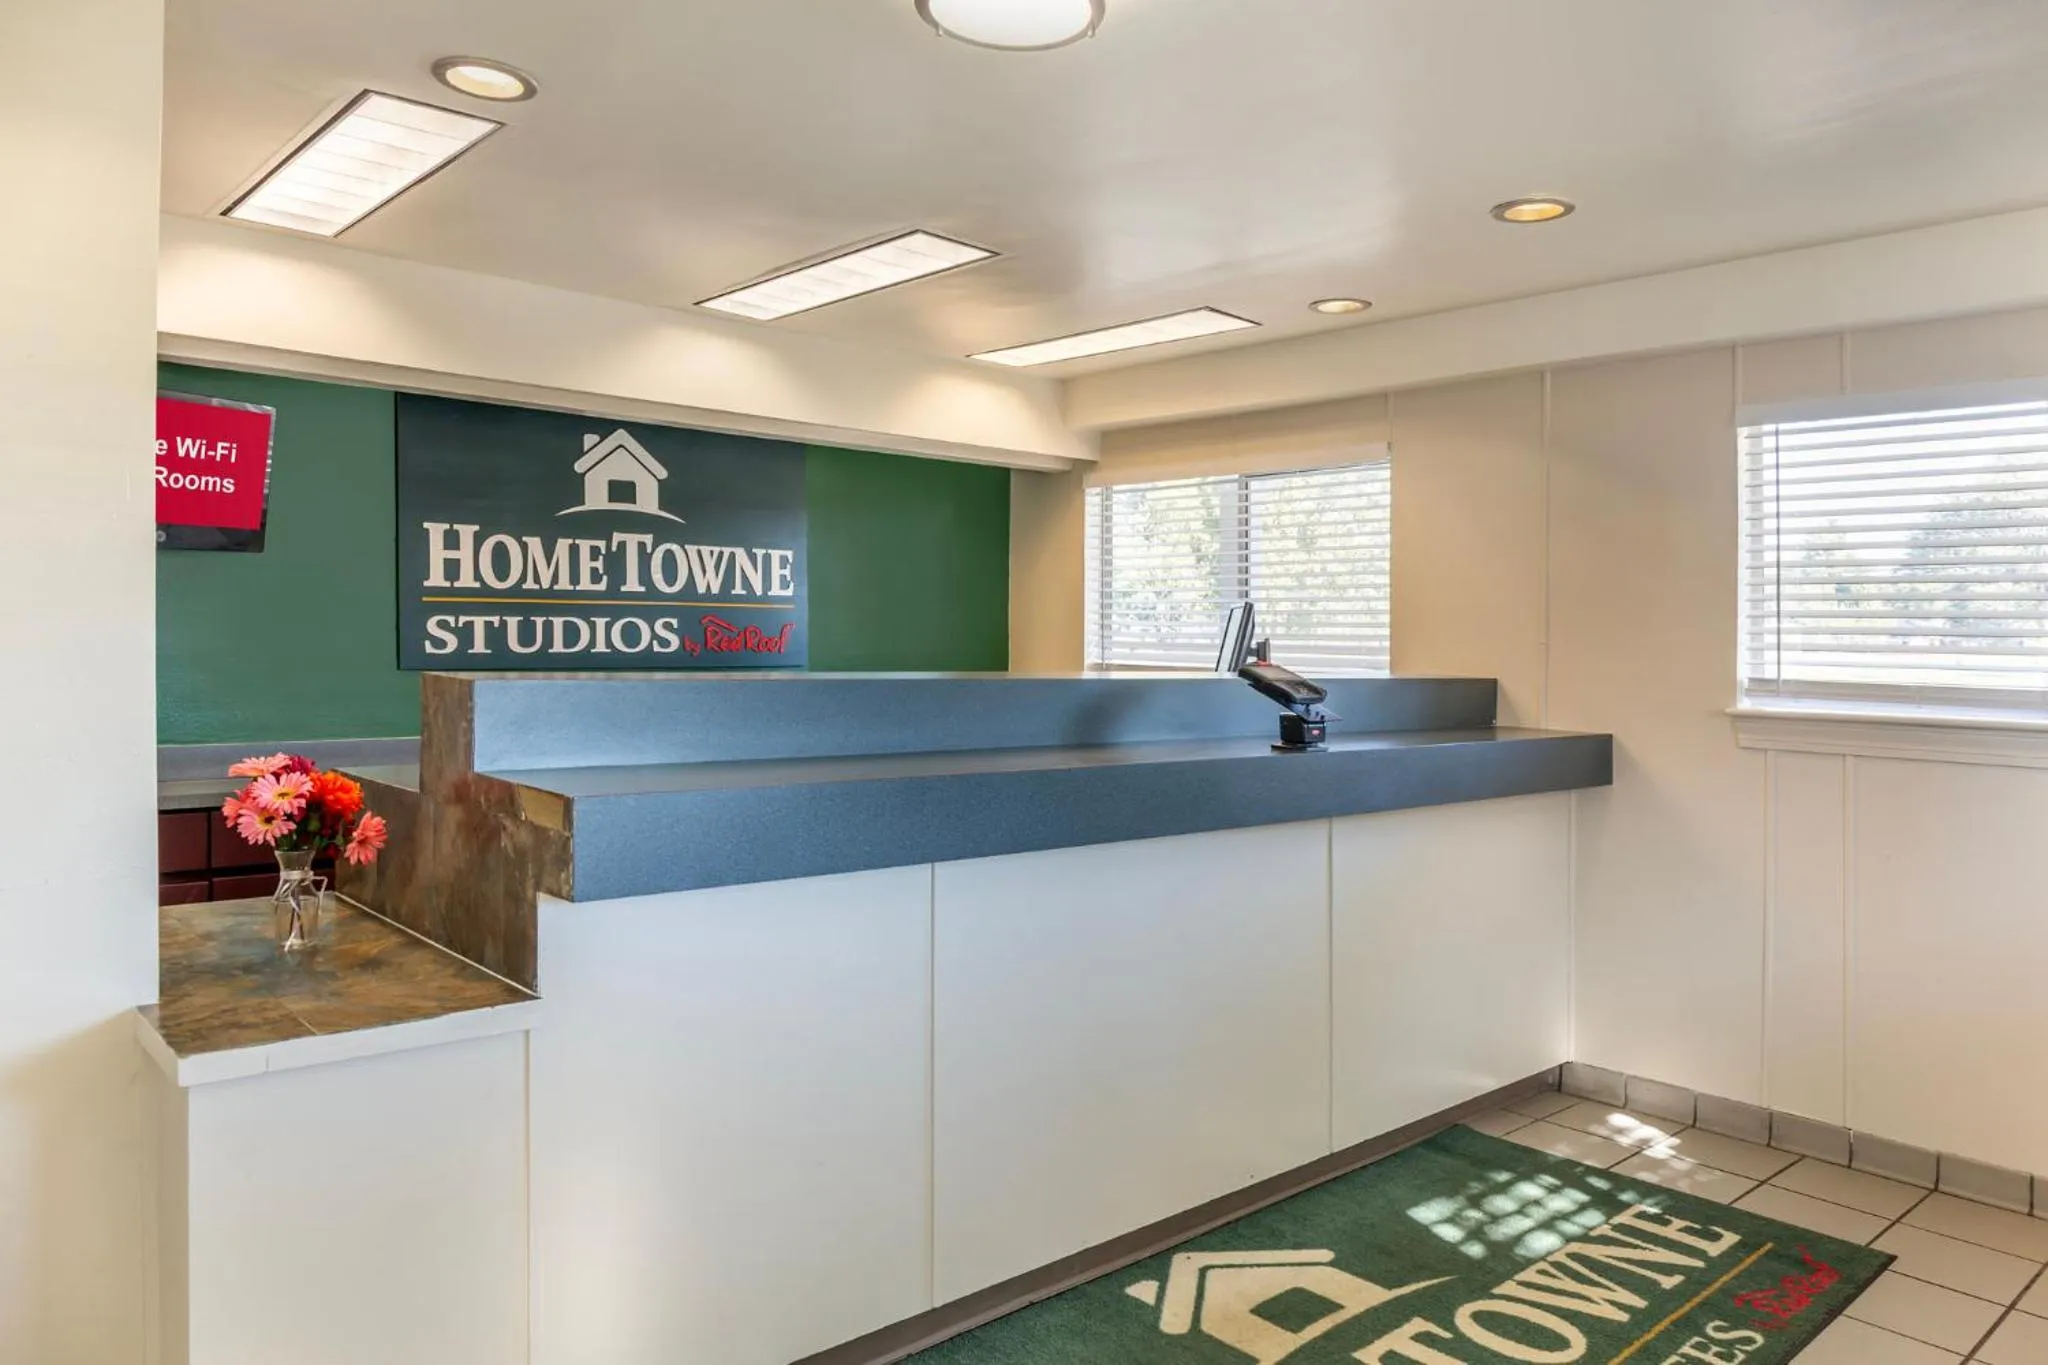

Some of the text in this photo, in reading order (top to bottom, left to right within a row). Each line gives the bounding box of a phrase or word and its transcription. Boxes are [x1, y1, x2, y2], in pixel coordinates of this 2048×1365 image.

[176, 436, 238, 463] Wi-Fi
[155, 466, 235, 494] Rooms
[424, 614, 681, 655] STUDIOS
